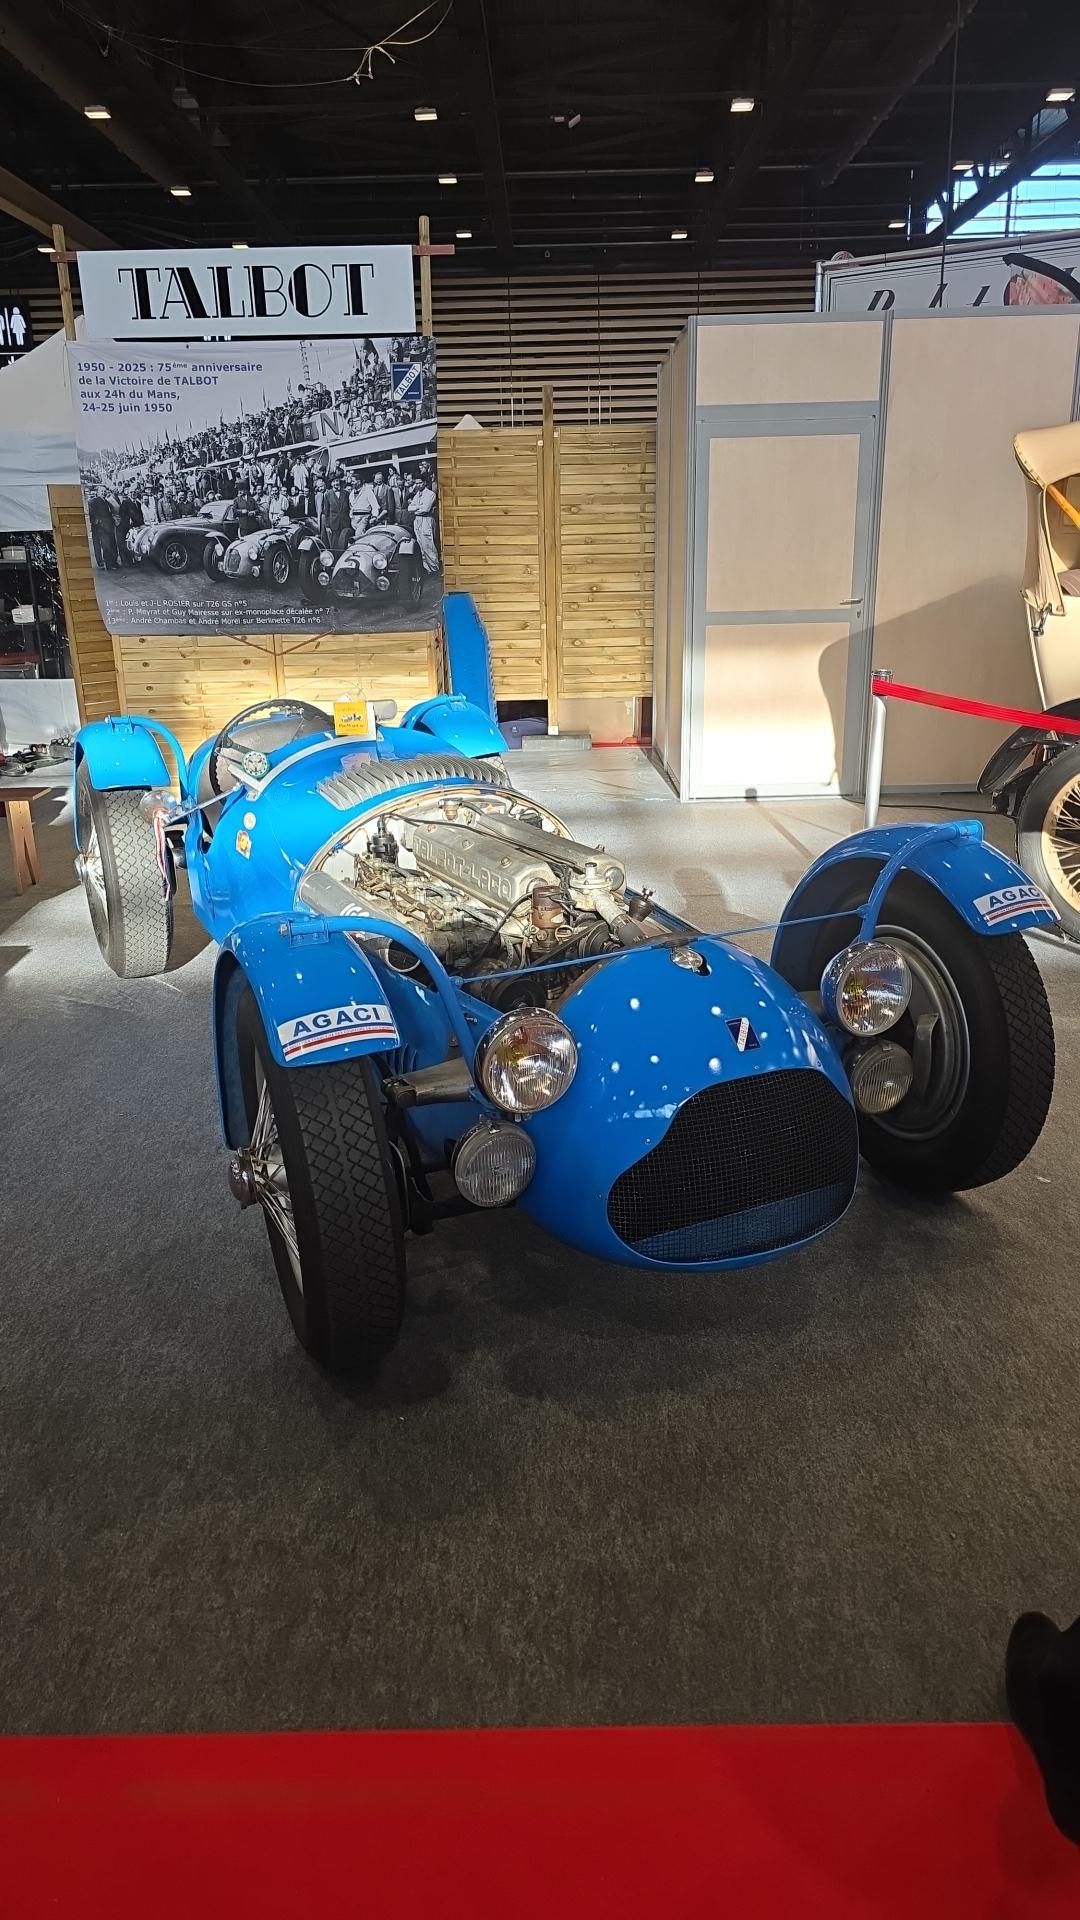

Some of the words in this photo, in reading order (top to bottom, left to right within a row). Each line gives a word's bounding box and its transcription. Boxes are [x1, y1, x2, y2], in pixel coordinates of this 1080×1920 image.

[117, 263, 374, 321] TALBOT
[77, 362, 105, 372] 1950
[117, 363, 146, 372] 2025
[157, 362, 188, 372] 75ème
[191, 362, 263, 372] anniversaire
[79, 376, 92, 385] de
[95, 375, 106, 385] la
[108, 376, 154, 386] Victoire
[157, 376, 171, 386] de
[174, 376, 218, 386] TALBOT
[394, 365, 419, 396] TALBOT
[80, 391, 101, 399] aux
[104, 389, 126, 399] 24h
[129, 389, 143, 399] du
[147, 390, 180, 401] Mans,
[82, 402, 115, 412] 24-25
[118, 403, 140, 415] juin
[144, 403, 173, 412] 1950
[320, 411, 343, 436] N
[171, 609, 186, 617] Guy
[235, 608, 284, 616] ex-monoplace
[292, 616, 306, 624] T26
[989, 887, 1044, 908] AGAC
[293, 1007, 380, 1037] AGACI
[739, 1021, 749, 1046] TALBOT
